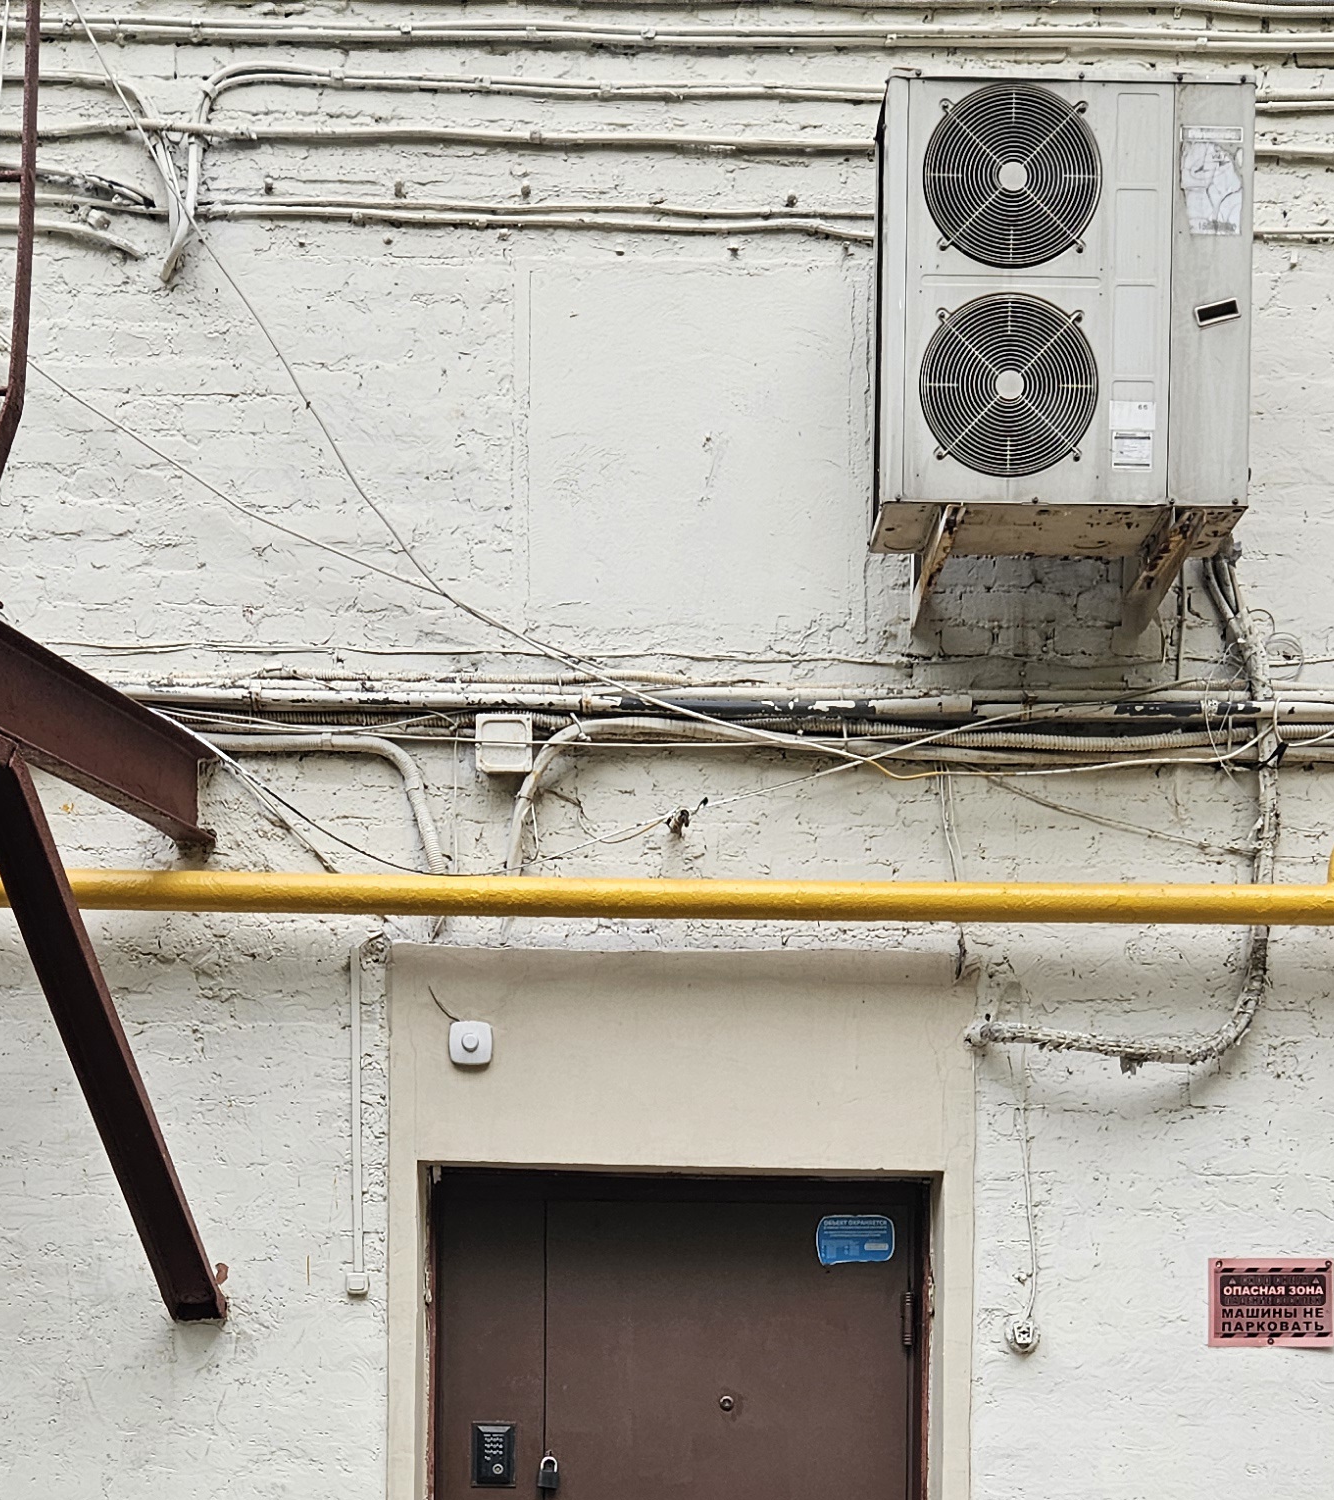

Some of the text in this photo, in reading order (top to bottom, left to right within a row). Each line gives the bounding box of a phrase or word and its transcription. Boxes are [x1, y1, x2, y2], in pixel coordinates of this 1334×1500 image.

[1223, 1285, 1324, 1296] ОПАСНАЯ ЗОНА
[1221, 1307, 1324, 1319] МАШИНЫ НЕ
[1221, 1321, 1324, 1332] ПАРКОВАТЬ
